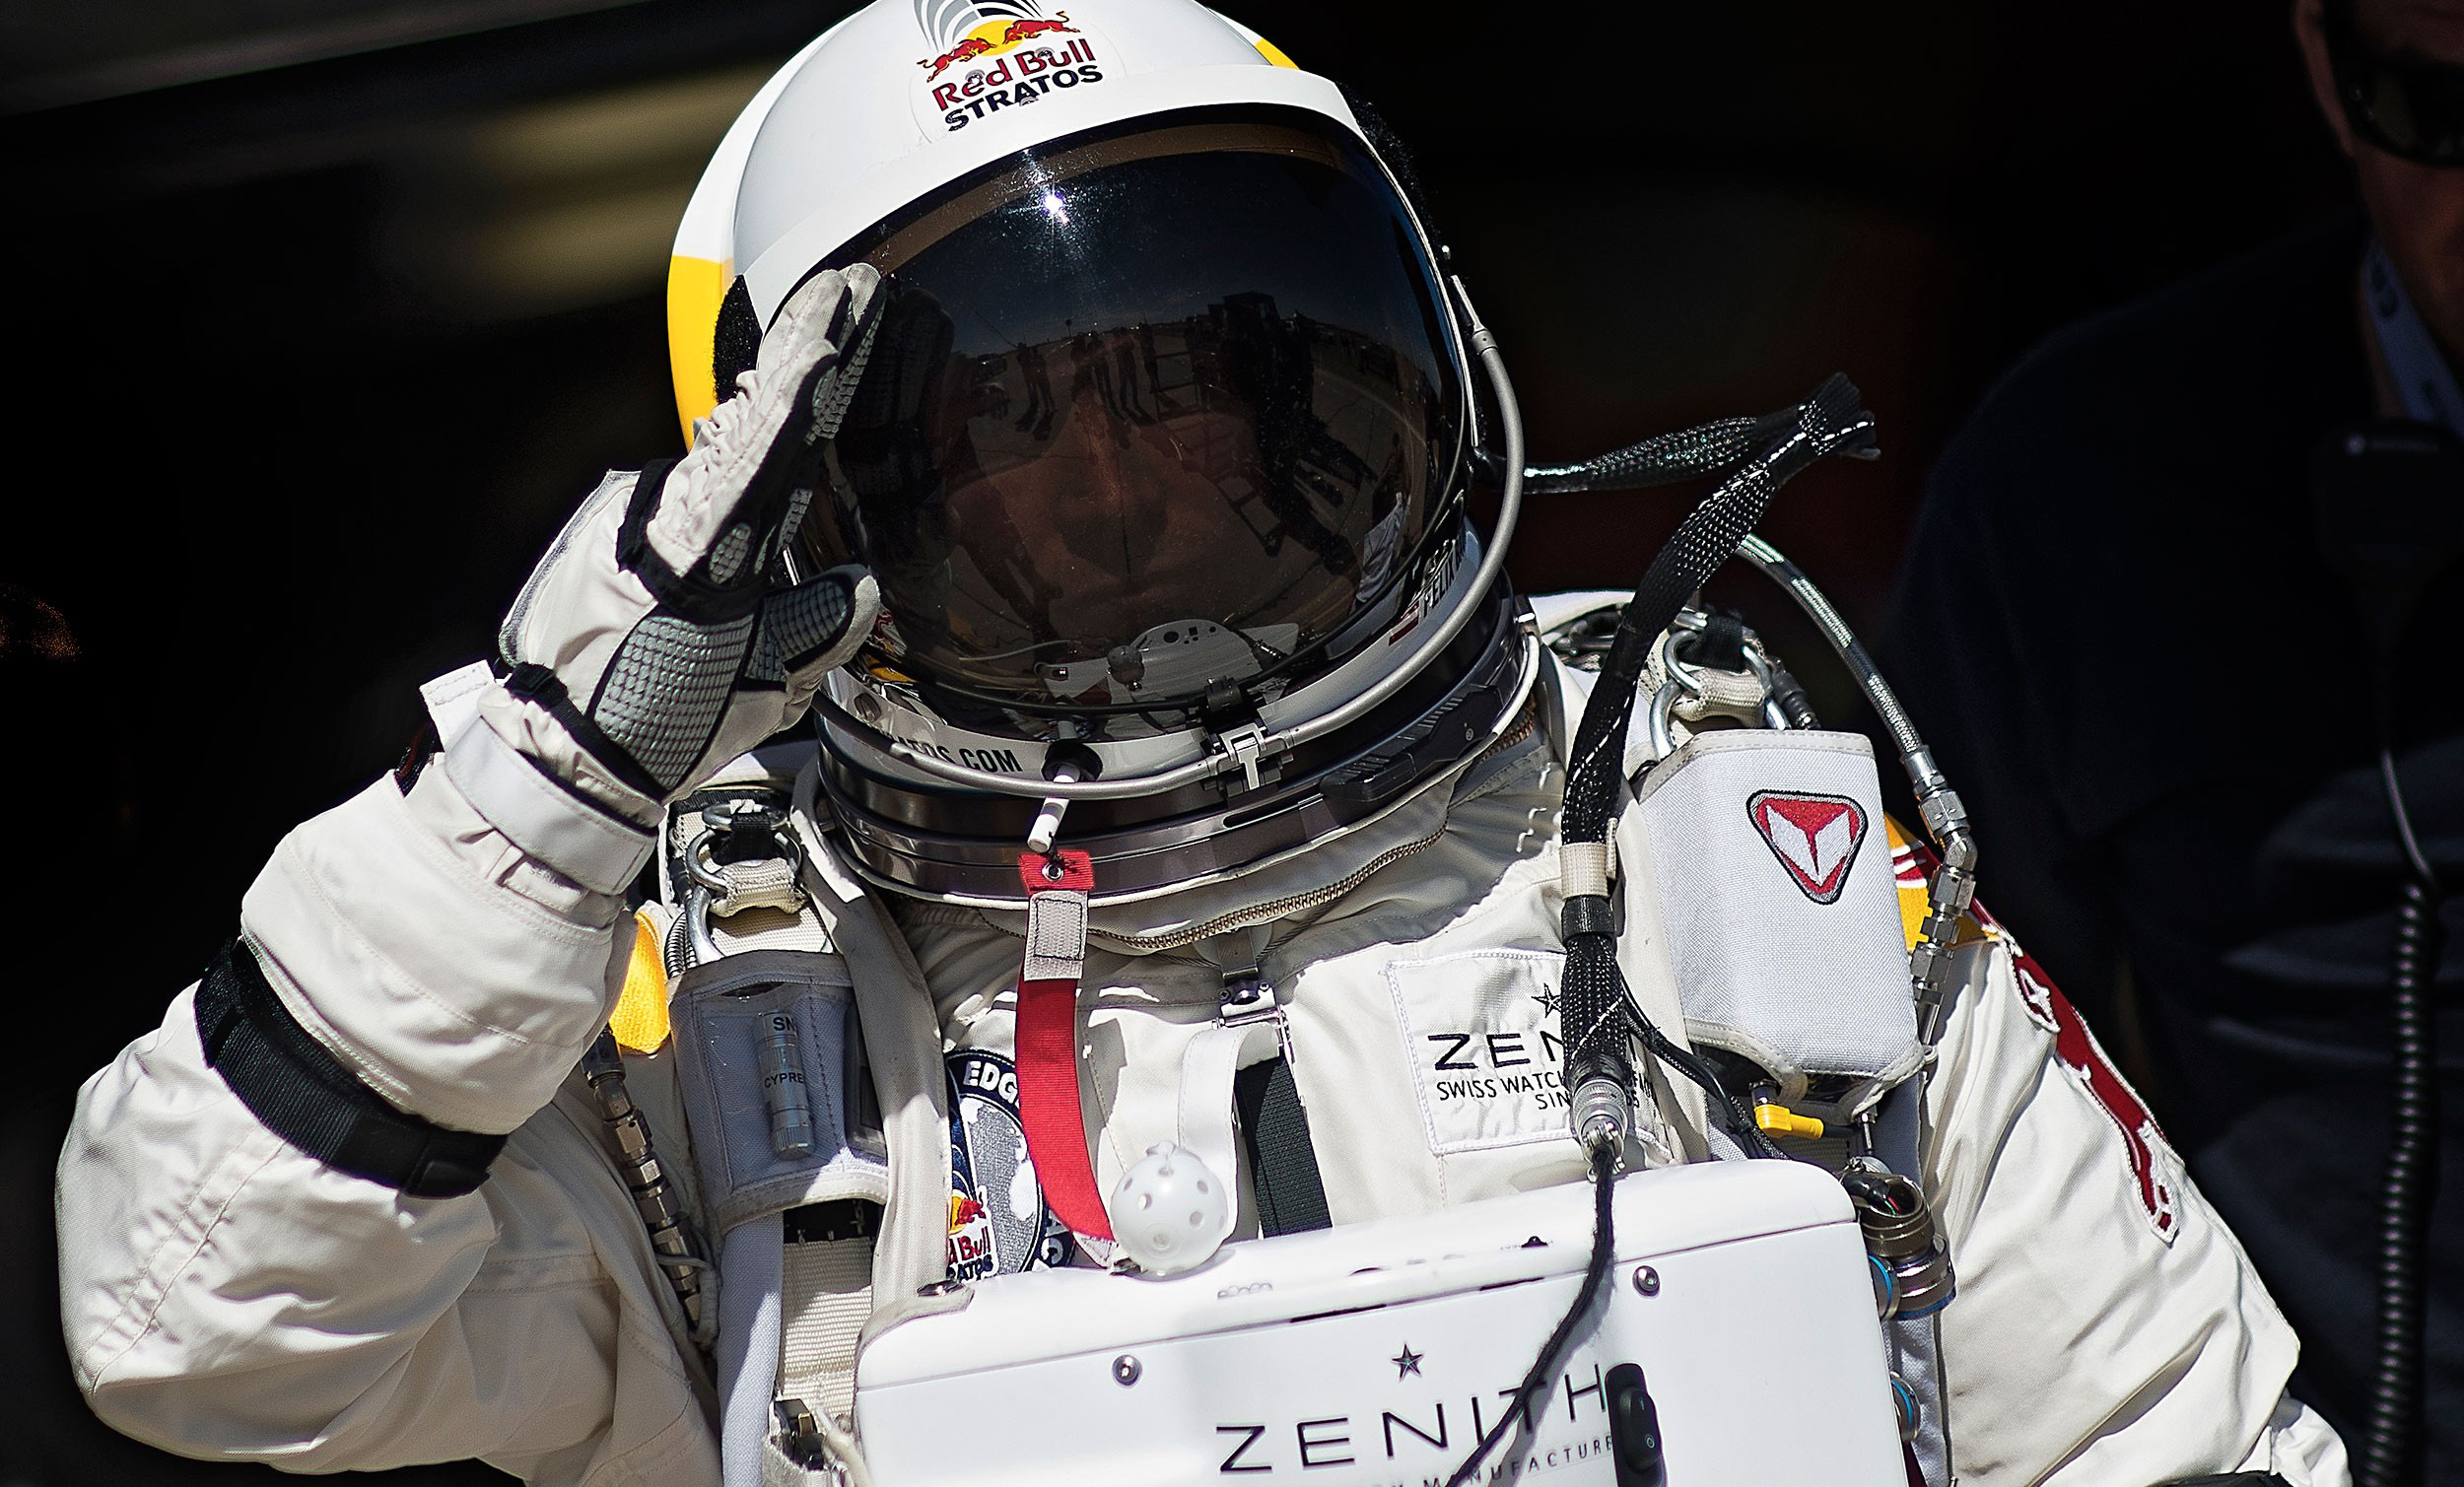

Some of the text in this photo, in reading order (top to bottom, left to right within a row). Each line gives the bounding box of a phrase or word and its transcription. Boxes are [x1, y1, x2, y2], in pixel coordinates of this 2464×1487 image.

[931, 38, 1096, 112] Red Bull
[944, 65, 1103, 132] STRATOS
[1428, 1030, 1564, 1071] ZEN
[963, 1060, 1020, 1106] EDG
[1436, 1079, 1497, 1101] SWISS
[1536, 1090, 1572, 1111] SIN
[957, 1225, 991, 1261] Bull
[1215, 1363, 1608, 1474] ZENITH
